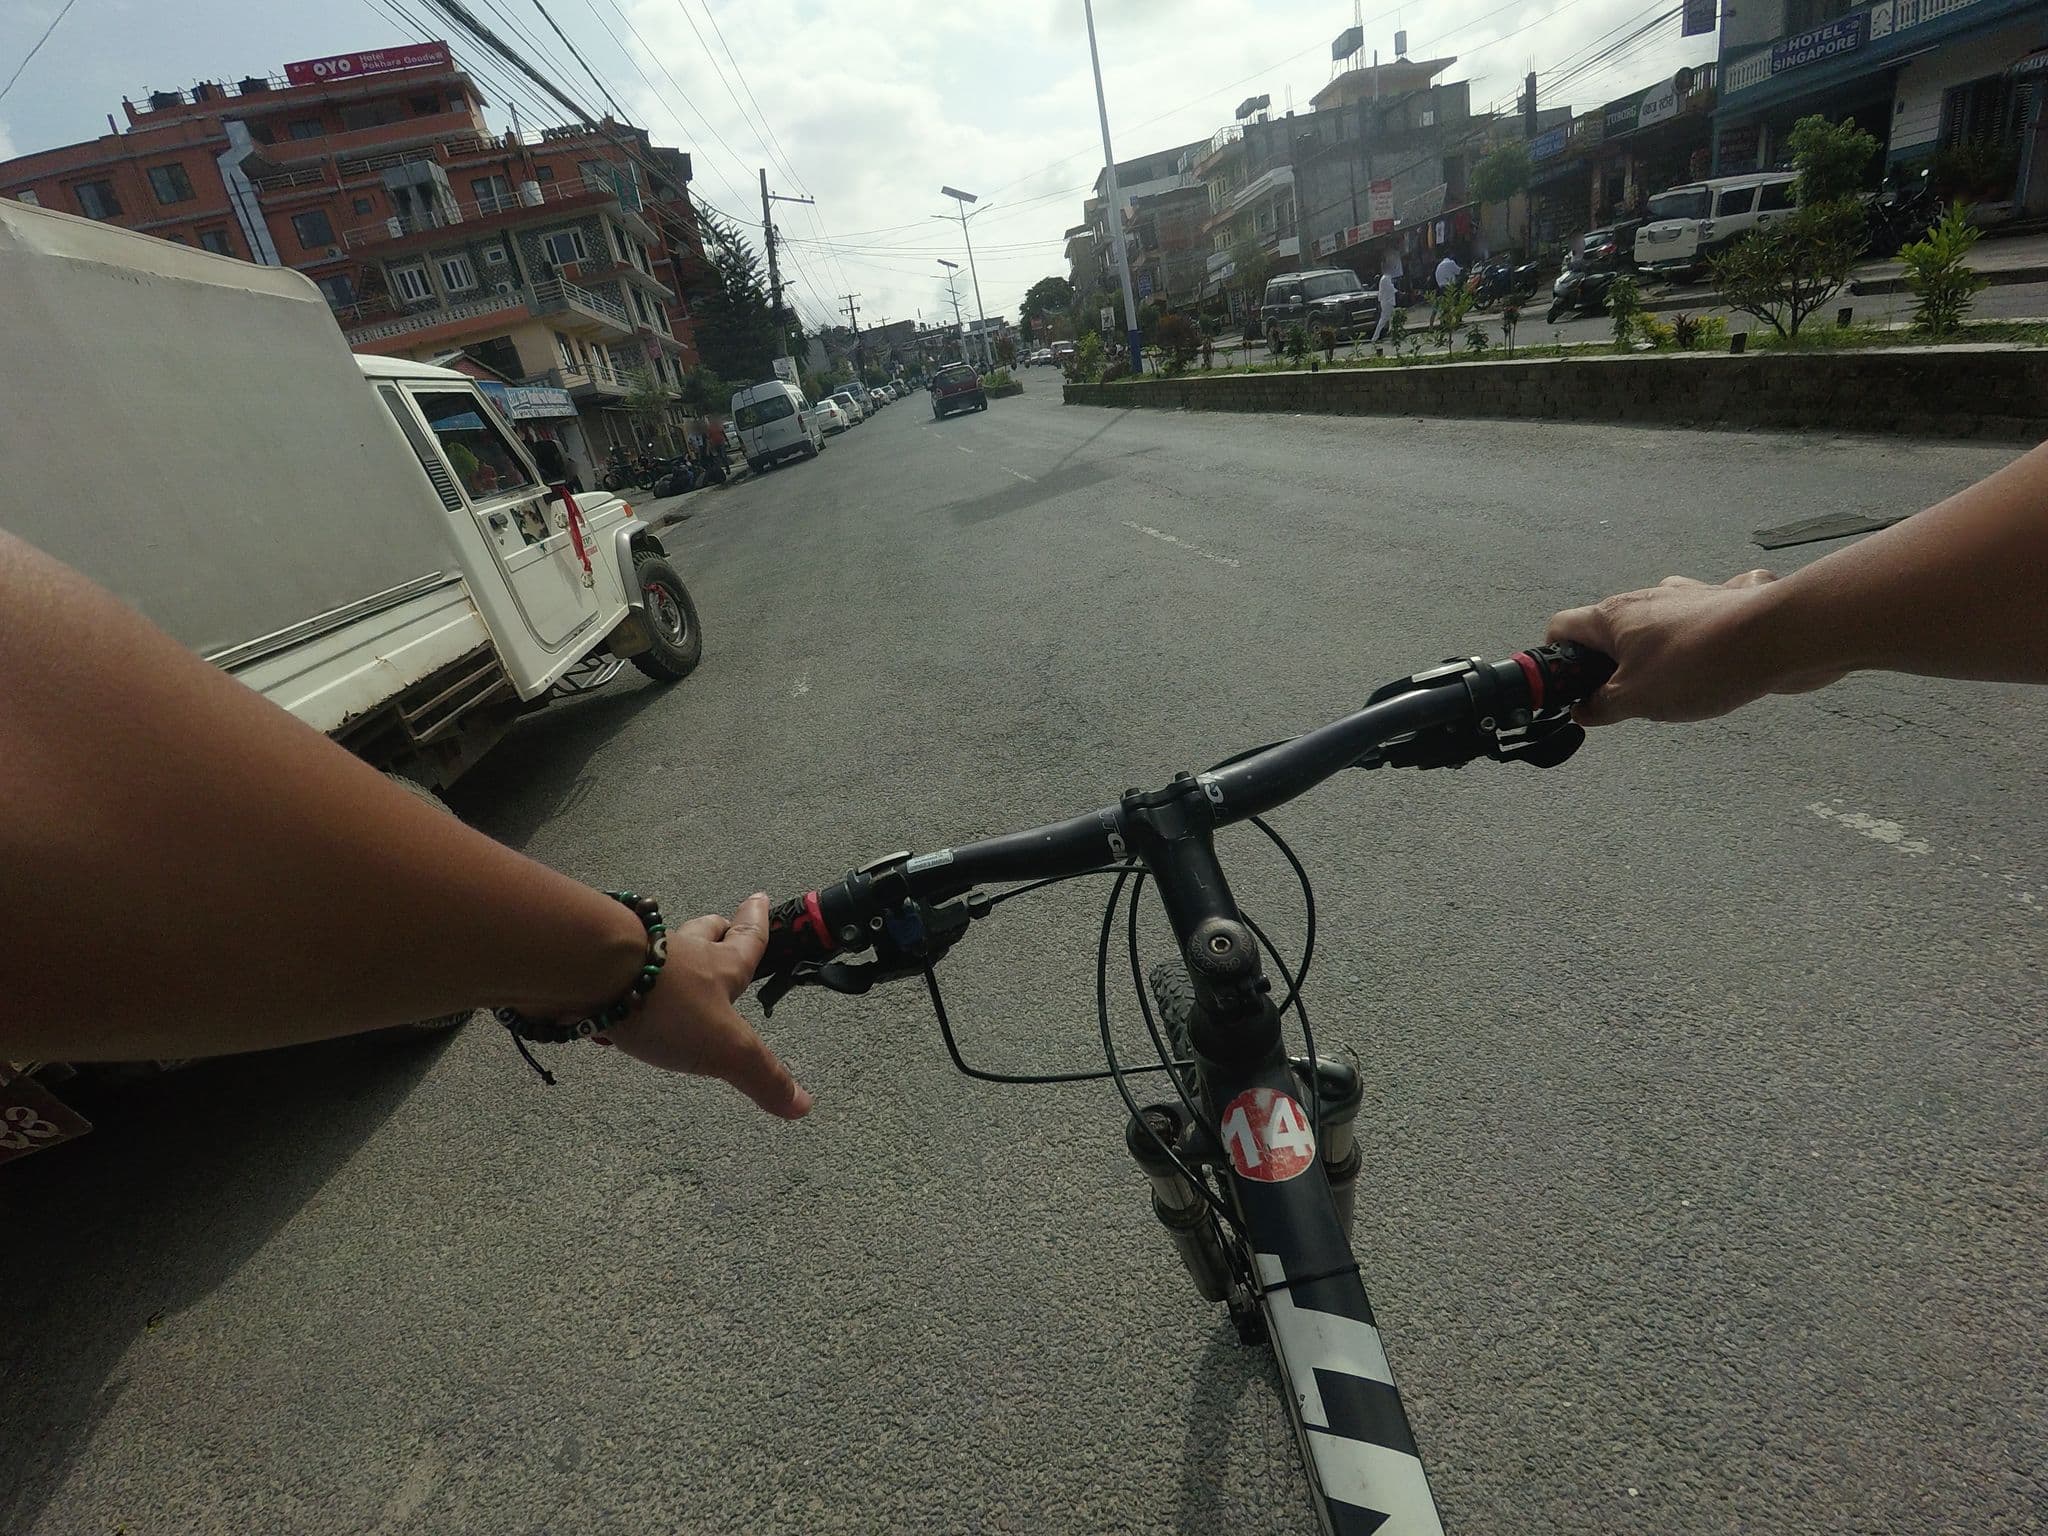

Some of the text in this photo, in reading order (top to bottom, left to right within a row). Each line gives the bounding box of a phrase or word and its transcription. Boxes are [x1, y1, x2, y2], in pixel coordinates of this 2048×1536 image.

[1788, 24, 1843, 52] HOTEL
[359, 53, 385, 64] Hotel
[1772, 33, 1857, 72] SINGAPORE
[313, 59, 350, 76] OYO
[361, 59, 402, 71] Pokhara
[1223, 1097, 1310, 1169] 14
